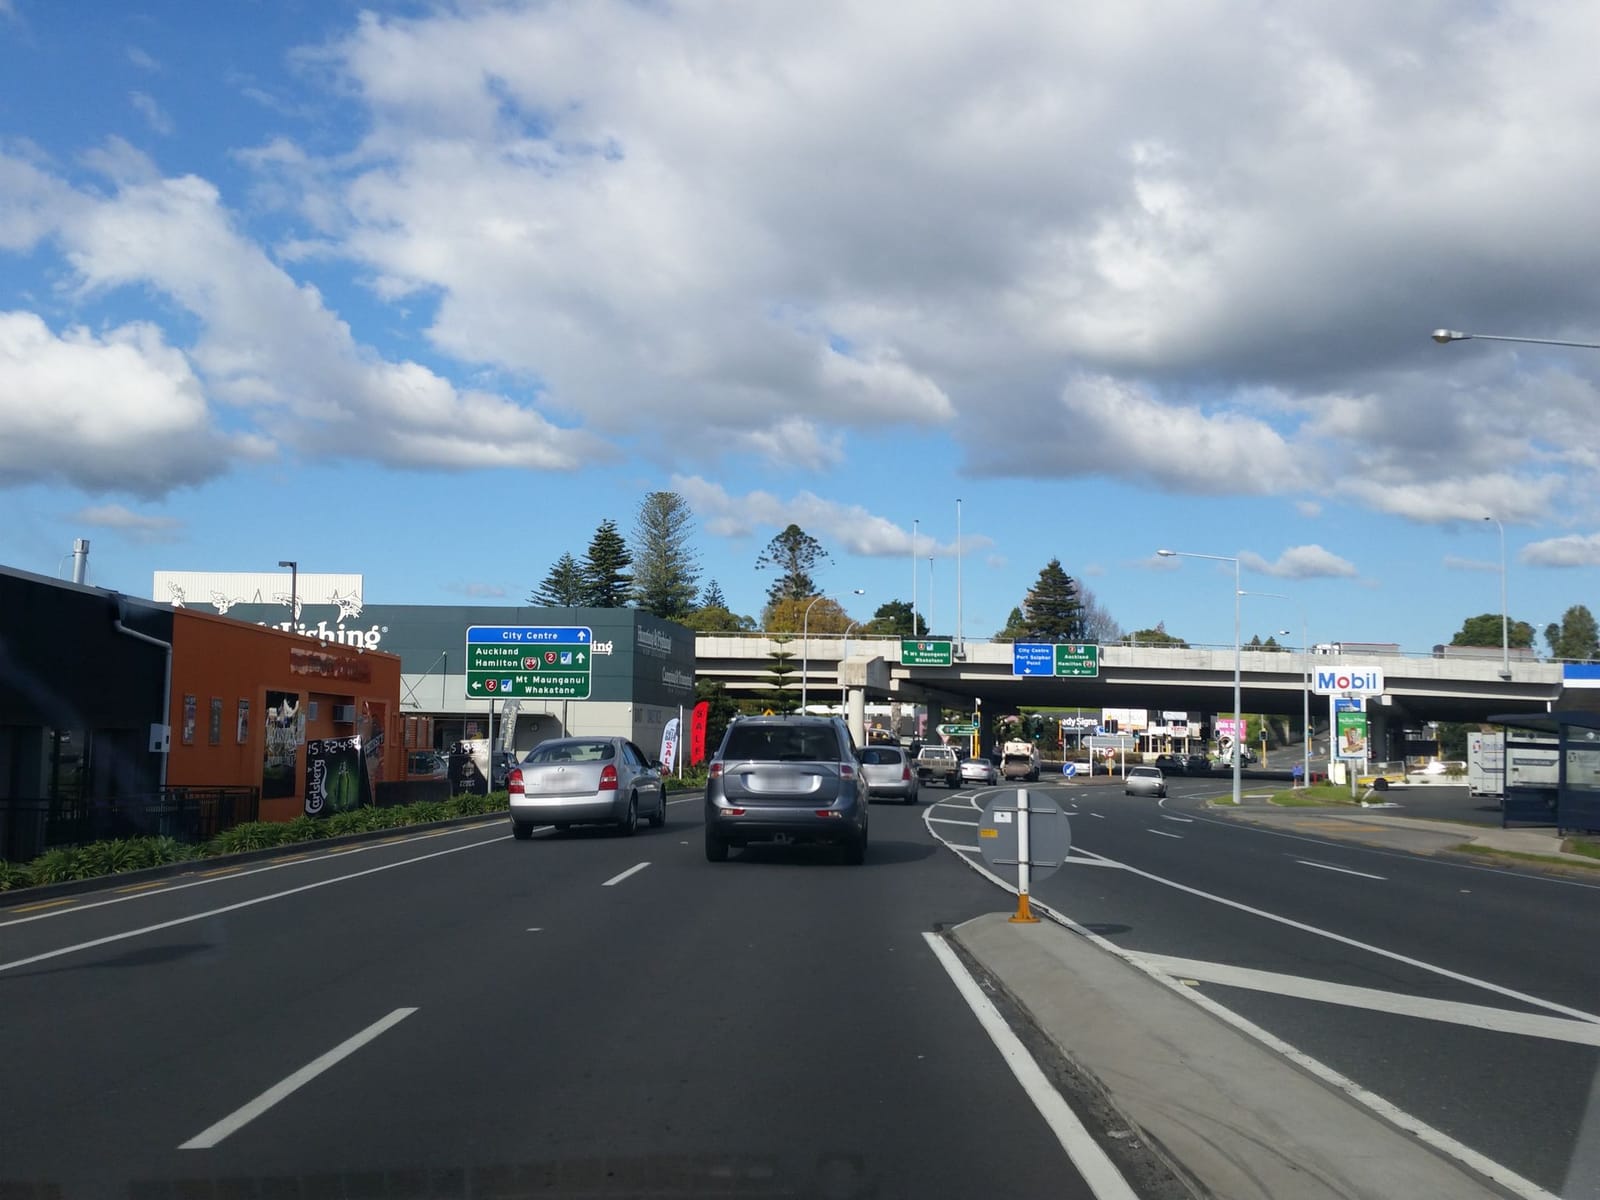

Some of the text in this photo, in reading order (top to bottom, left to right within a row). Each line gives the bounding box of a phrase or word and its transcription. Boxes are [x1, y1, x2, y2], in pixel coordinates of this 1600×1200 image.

[502, 631, 558, 641] City Centre
[475, 659, 518, 667] Hamilton
[515, 676, 585, 685] Mt Maunganui
[1318, 672, 1376, 689] Mobil
[524, 686, 575, 694] Whakatane
[1076, 717, 1099, 728] Signs
[305, 759, 328, 814] Carlsberg
